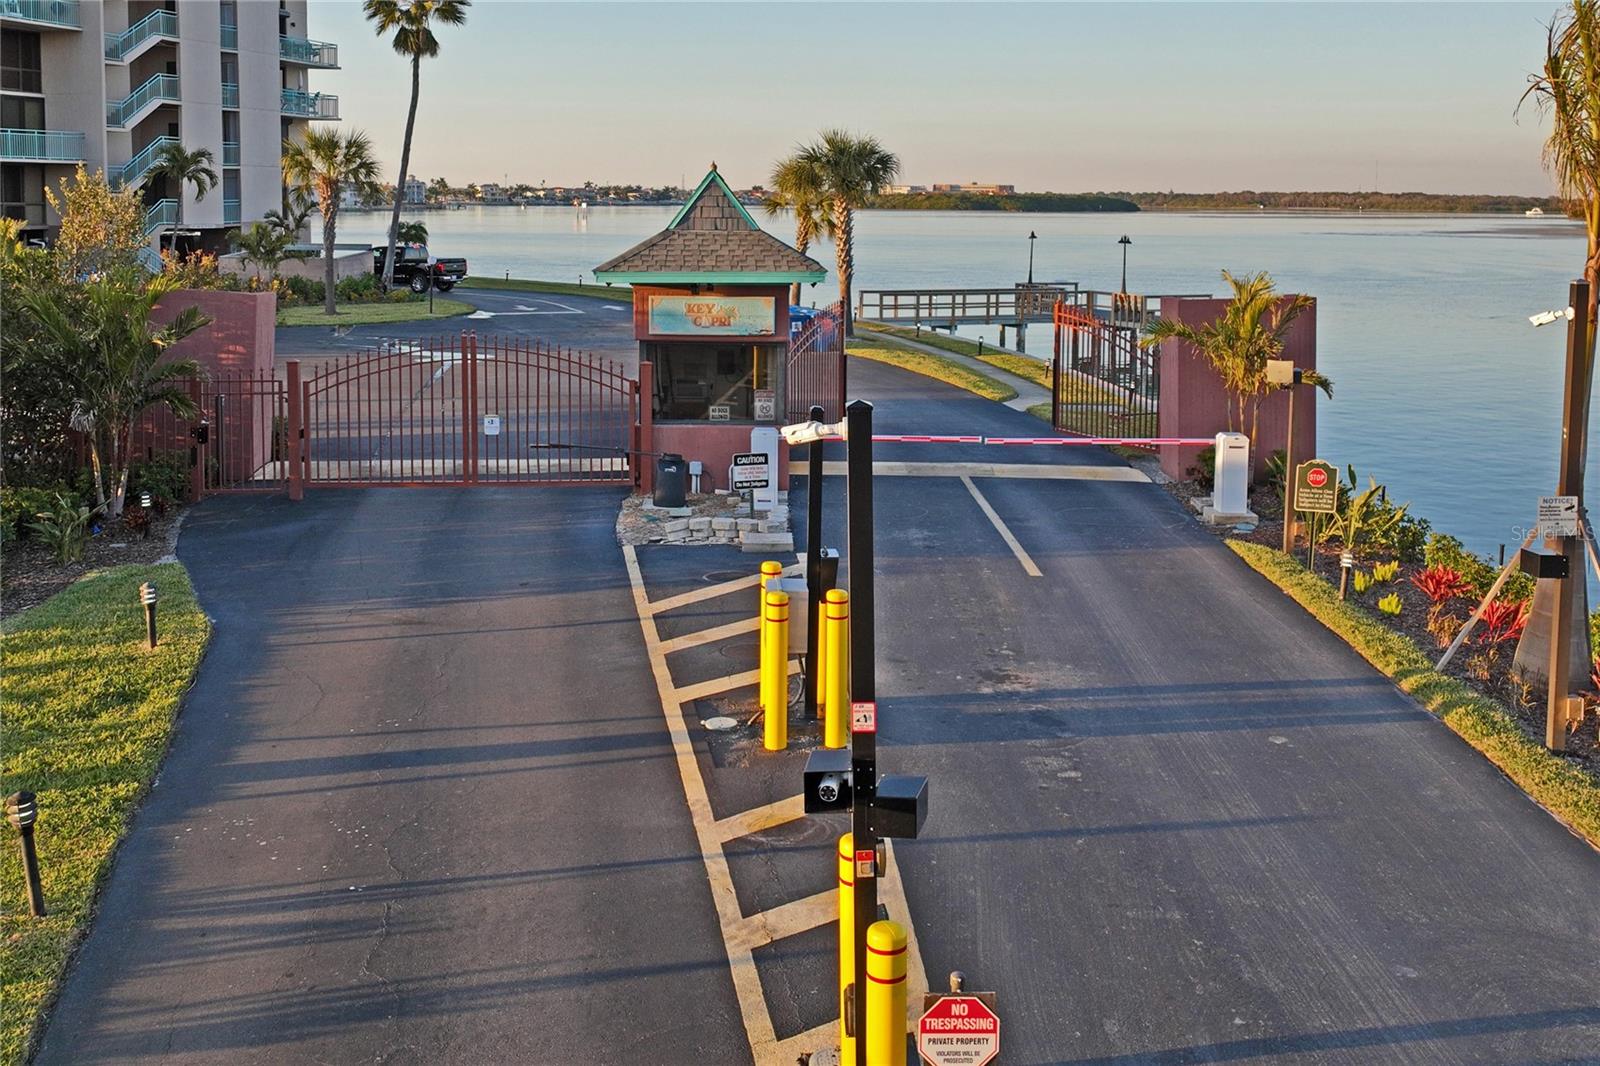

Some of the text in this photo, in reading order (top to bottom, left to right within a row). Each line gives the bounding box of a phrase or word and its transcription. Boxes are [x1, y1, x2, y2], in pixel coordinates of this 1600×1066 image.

[687, 303, 716, 314] KEY
[737, 456, 765, 465] CAUTION
[951, 1003, 969, 1016] NO
[924, 1018, 994, 1030] TRESPASSING
